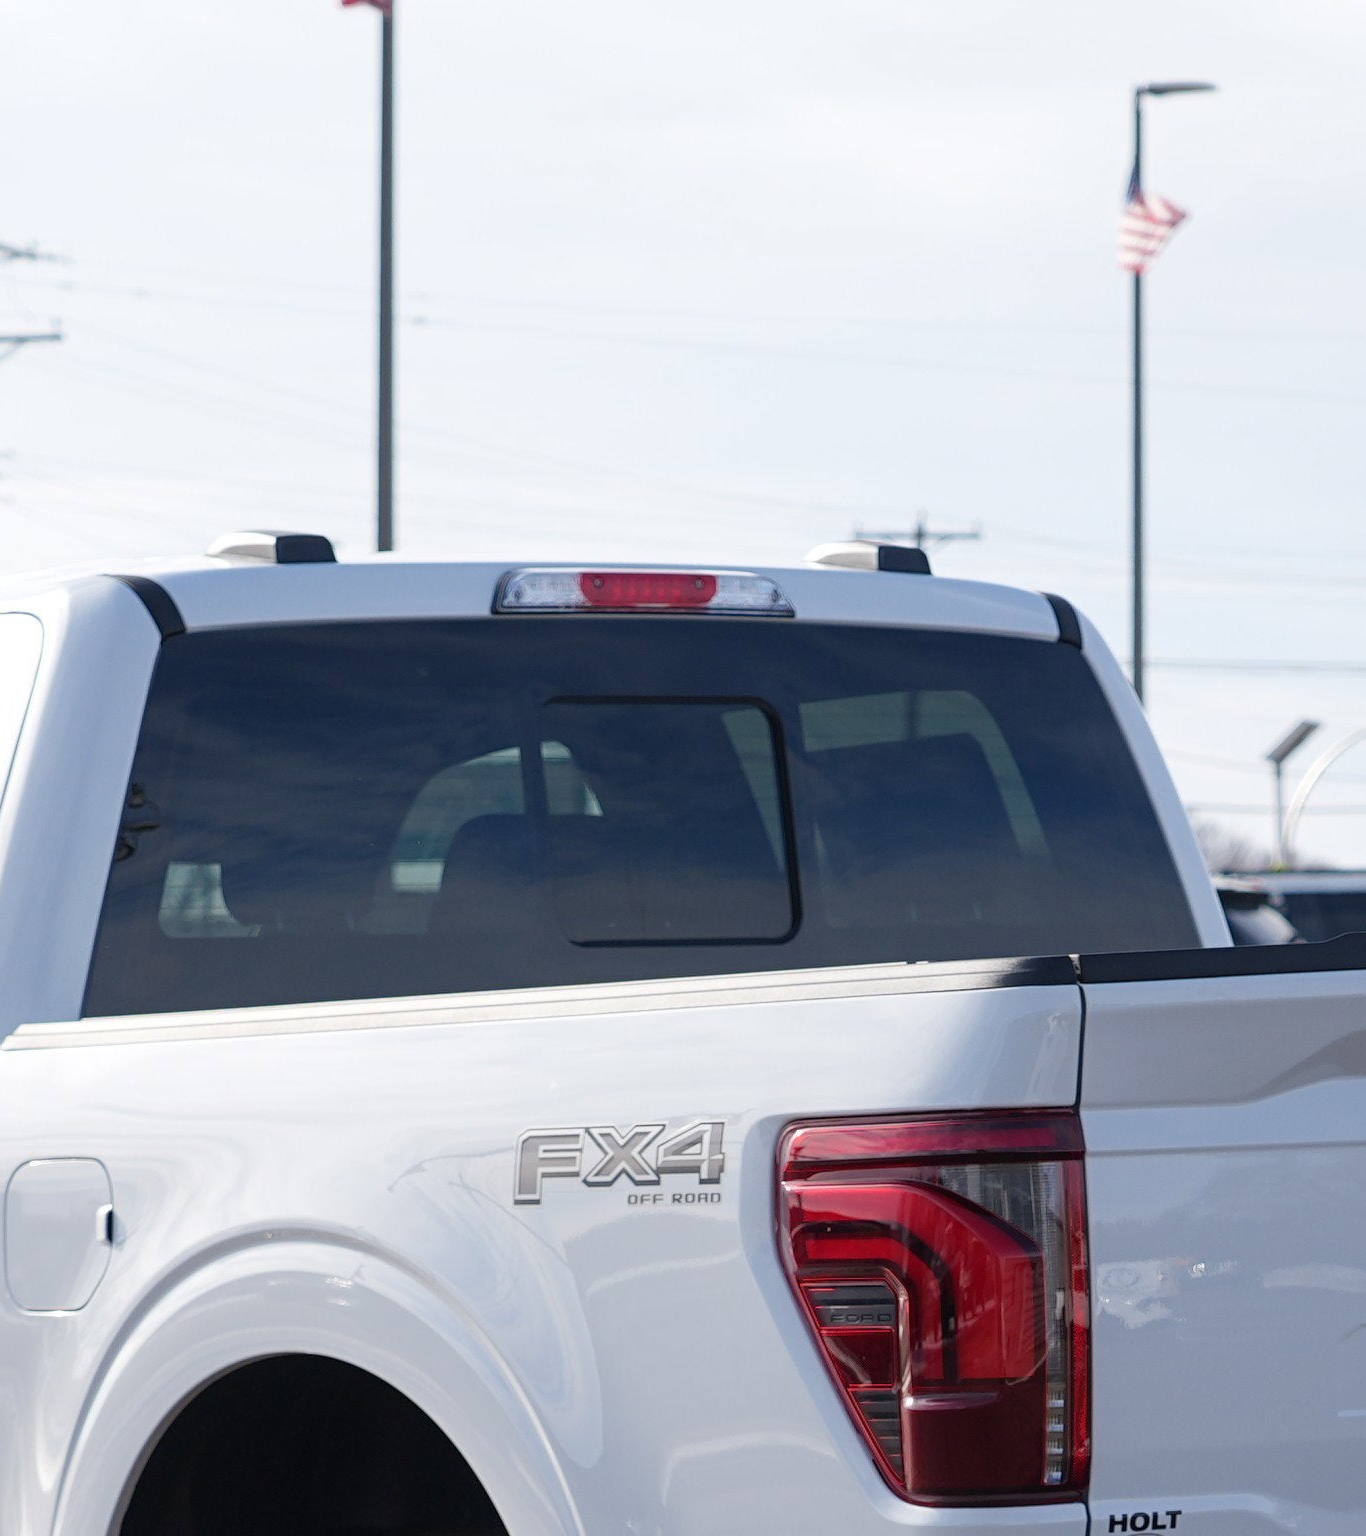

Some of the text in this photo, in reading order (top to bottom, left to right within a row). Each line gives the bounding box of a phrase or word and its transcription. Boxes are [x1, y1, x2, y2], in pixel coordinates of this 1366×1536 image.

[514, 1121, 725, 1204] FX4
[627, 1191, 721, 1206] OFF ROAD
[830, 1313, 892, 1323] FORD
[1109, 1511, 1182, 1532] HOLT
